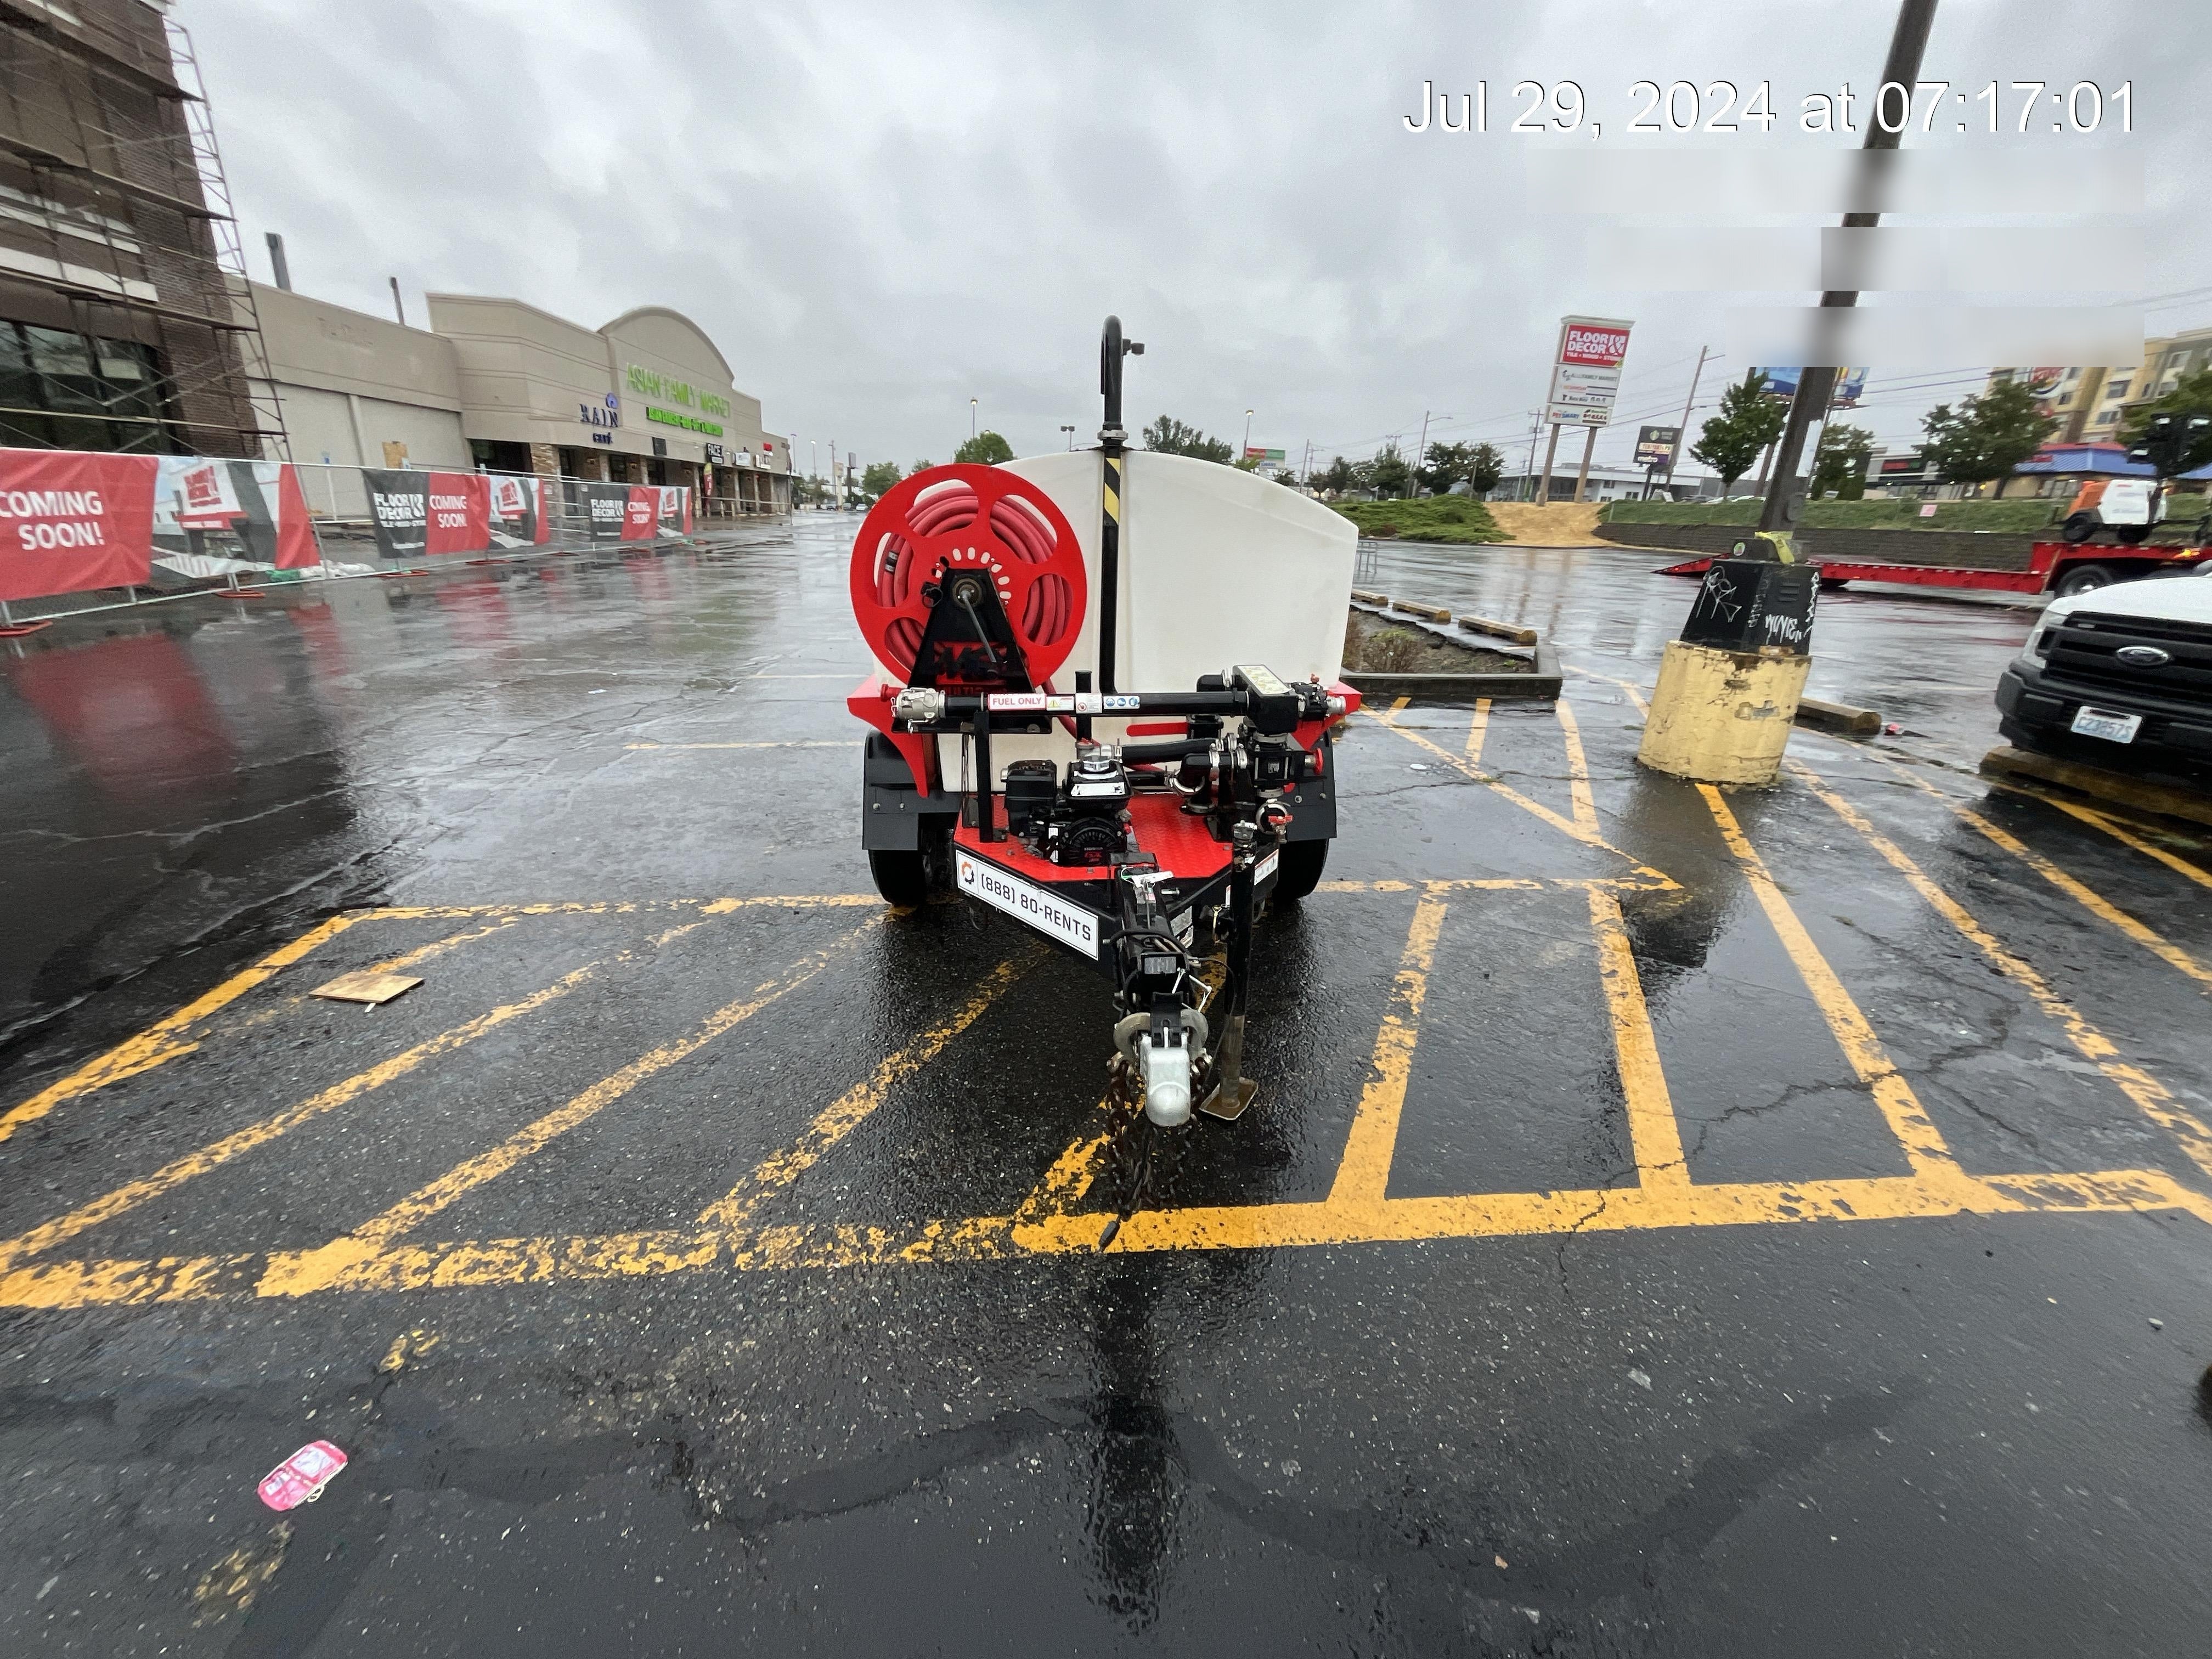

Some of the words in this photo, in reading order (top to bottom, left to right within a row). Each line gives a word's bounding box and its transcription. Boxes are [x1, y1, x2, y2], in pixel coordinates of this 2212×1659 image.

[1570, 330, 1608, 344] FLOOR
[1567, 341, 1606, 354] DECOR
[0, 490, 104, 518] COMING
[373, 492, 409, 506] FLOOR
[429, 495, 467, 510] COMING
[590, 499, 615, 509] FLOOR
[377, 506, 413, 520] DECOR
[591, 508, 616, 517] DECOR
[18, 521, 105, 550] SOON!
[992, 697, 1015, 706] FUEL
[1018, 697, 1042, 706] ONLY
[980, 873, 1015, 904] (888)
[1020, 893, 1091, 942] 80-RENTS
